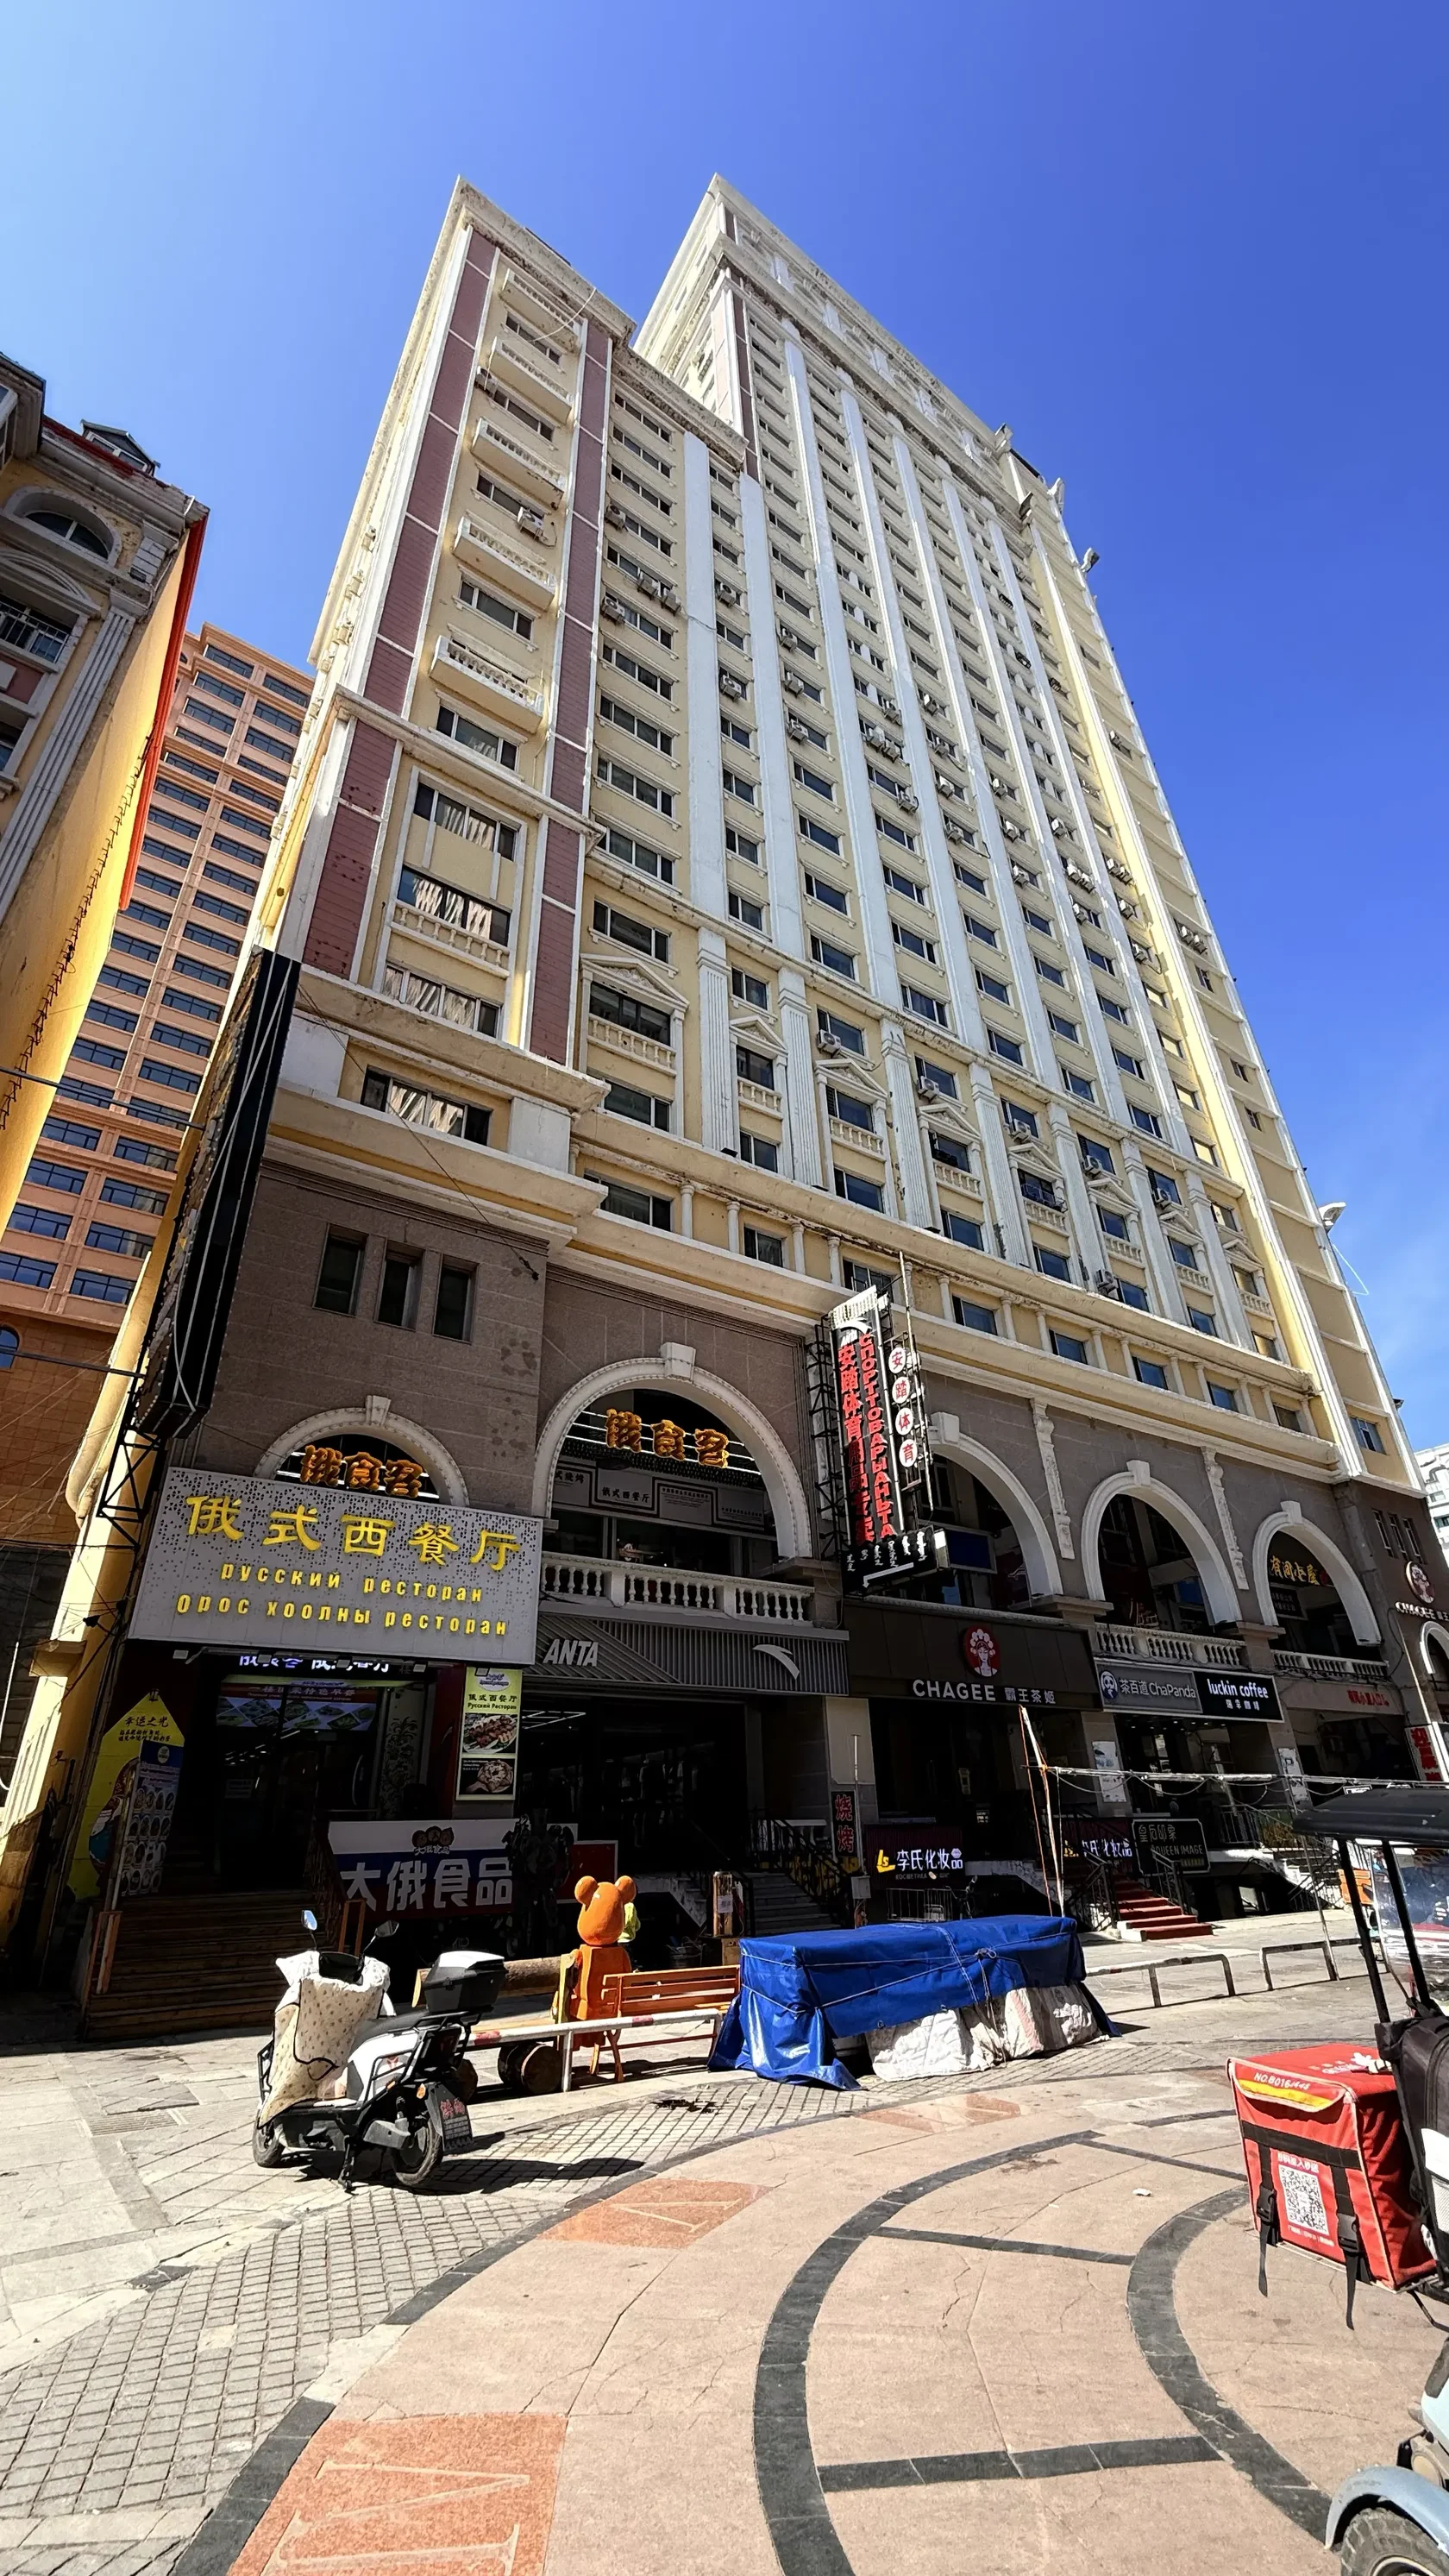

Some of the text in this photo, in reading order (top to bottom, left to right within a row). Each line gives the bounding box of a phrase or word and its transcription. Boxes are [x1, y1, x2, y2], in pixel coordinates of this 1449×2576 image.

[186, 1495, 522, 1573] 俄式西餐厅
[221, 1562, 483, 1603] русский ресторан
[267, 1599, 371, 1624] хоолны
[385, 1611, 507, 1637] ресторан
[543, 1638, 599, 1667] ANTA
[913, 1679, 1057, 1705] CHAGEE 霸王茶姬
[1120, 1679, 1197, 1699] 茶百道 ChaPanda
[1207, 1678, 1270, 1699] luckin coffee
[835, 1794, 855, 1853] 烧烤
[896, 1848, 963, 1871] 李氏化妆品
[1180, 1844, 1203, 1855] IMAGE
[340, 1857, 513, 1912] 大俄食品
